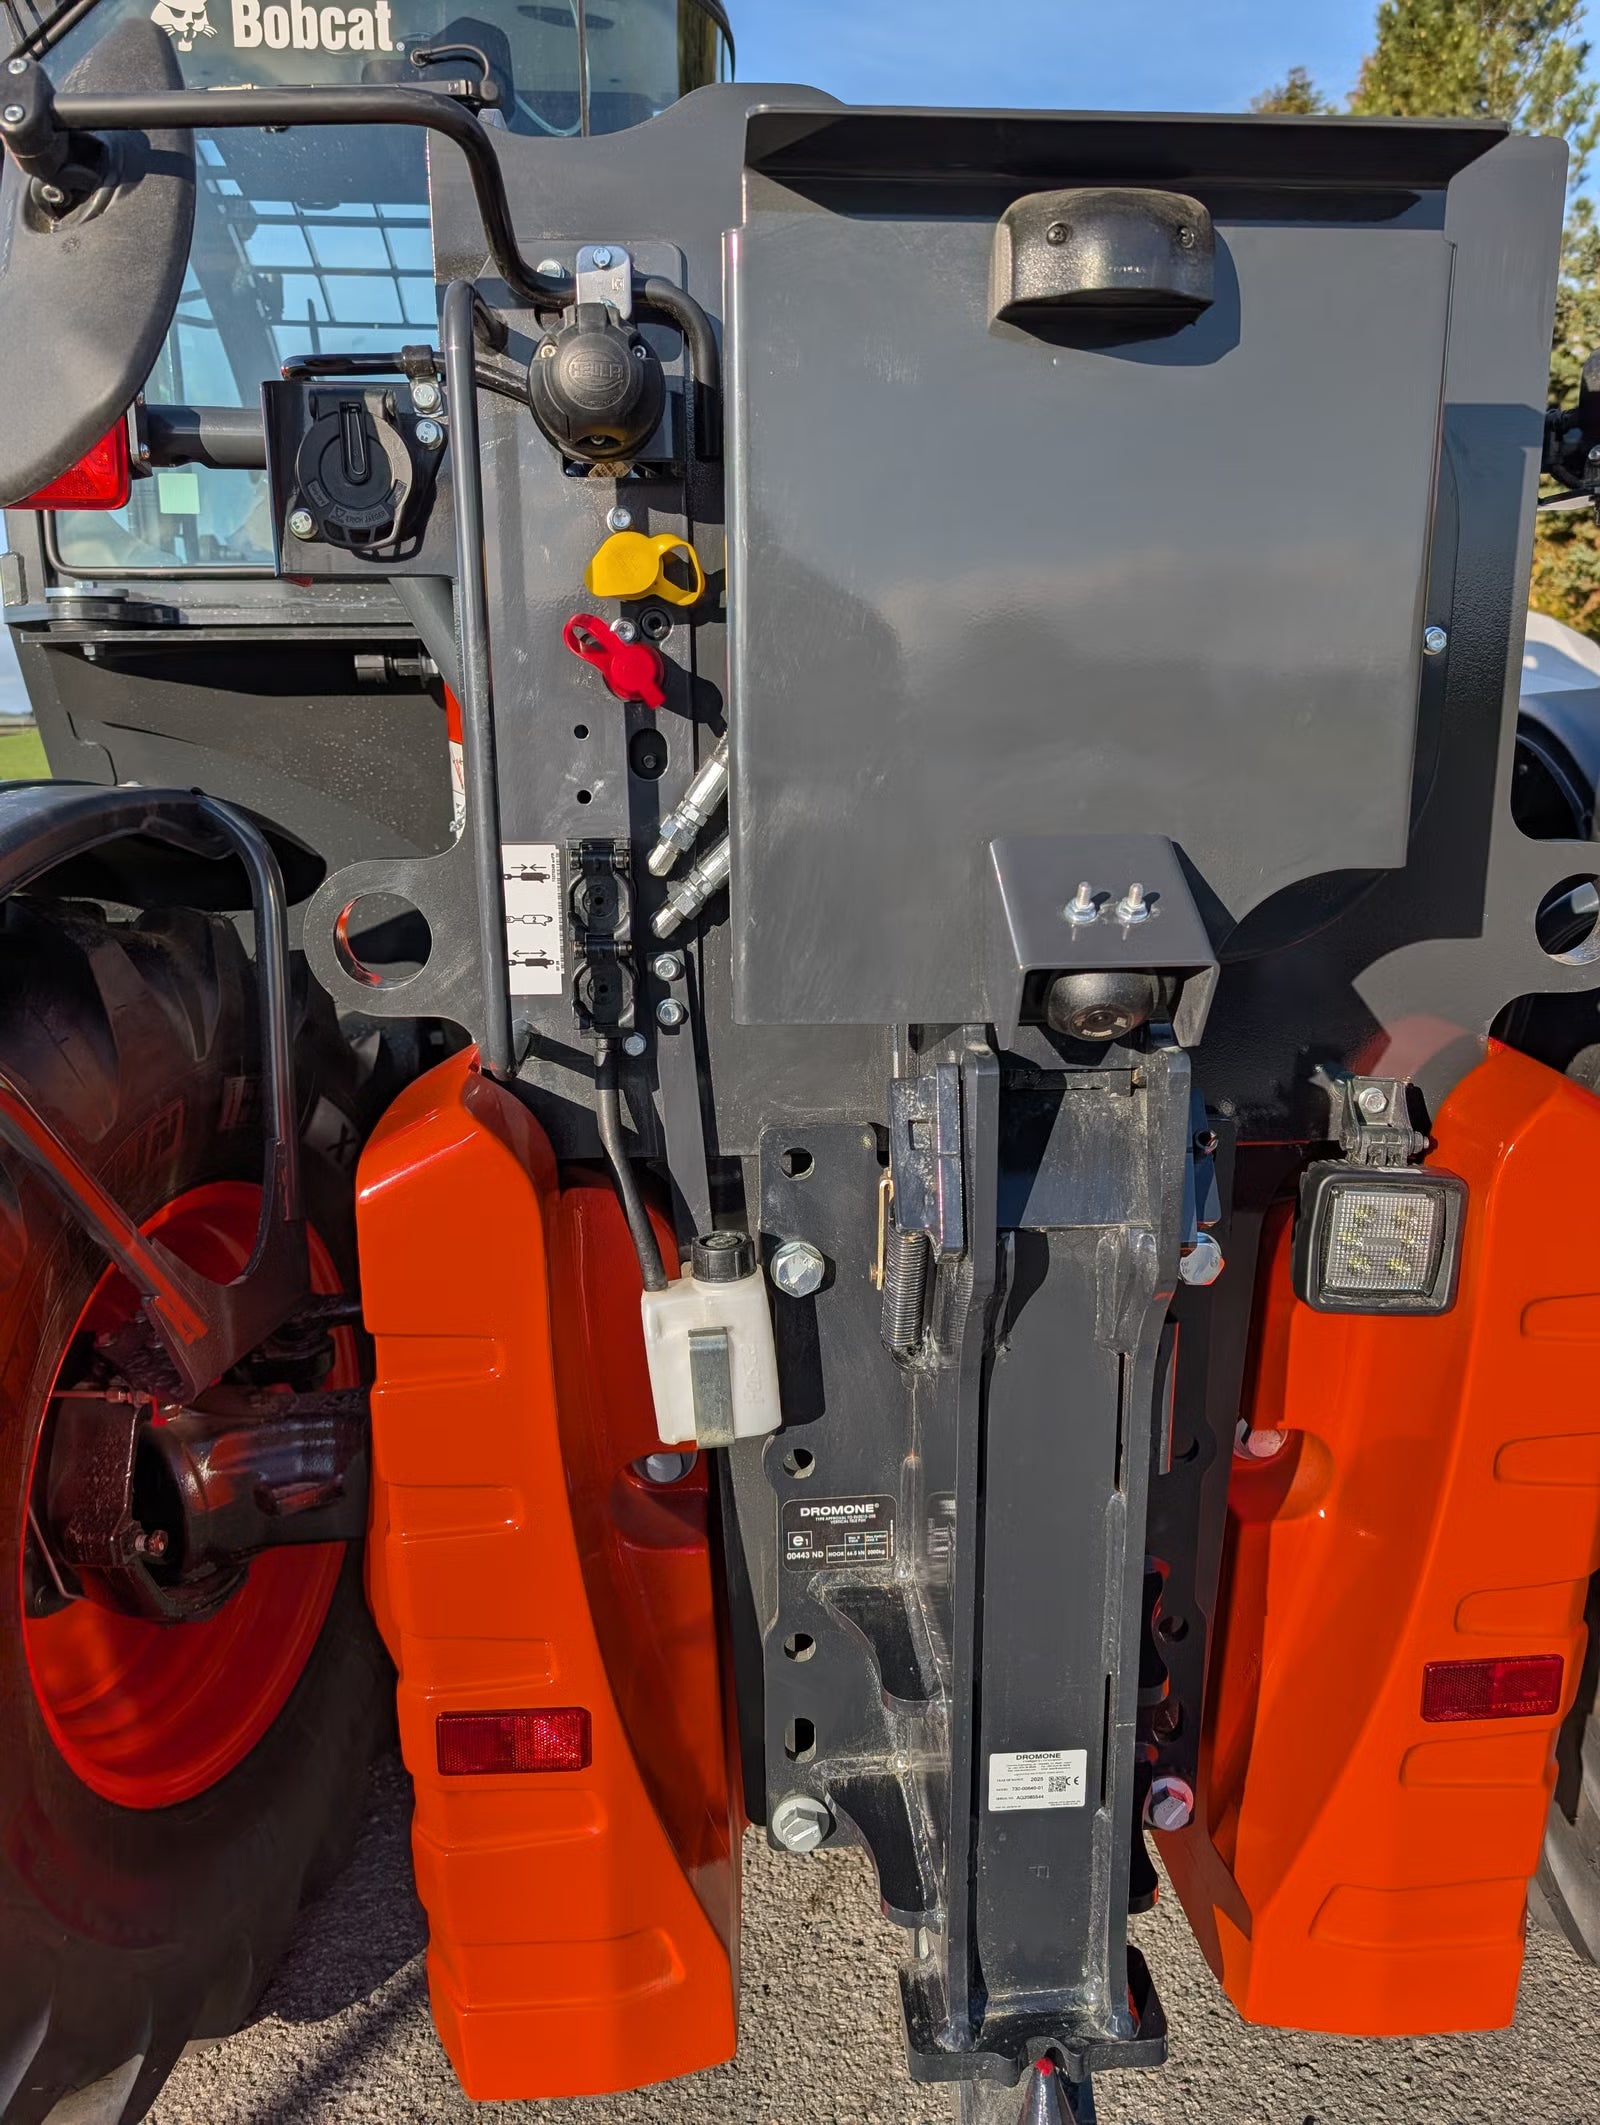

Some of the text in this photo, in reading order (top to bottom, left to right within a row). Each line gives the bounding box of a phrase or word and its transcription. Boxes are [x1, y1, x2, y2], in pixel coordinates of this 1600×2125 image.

[231, 0, 394, 51] Bobcat
[786, 1550, 824, 1560] 00443 ND
[1016, 1753, 1061, 1761] DROMONE
